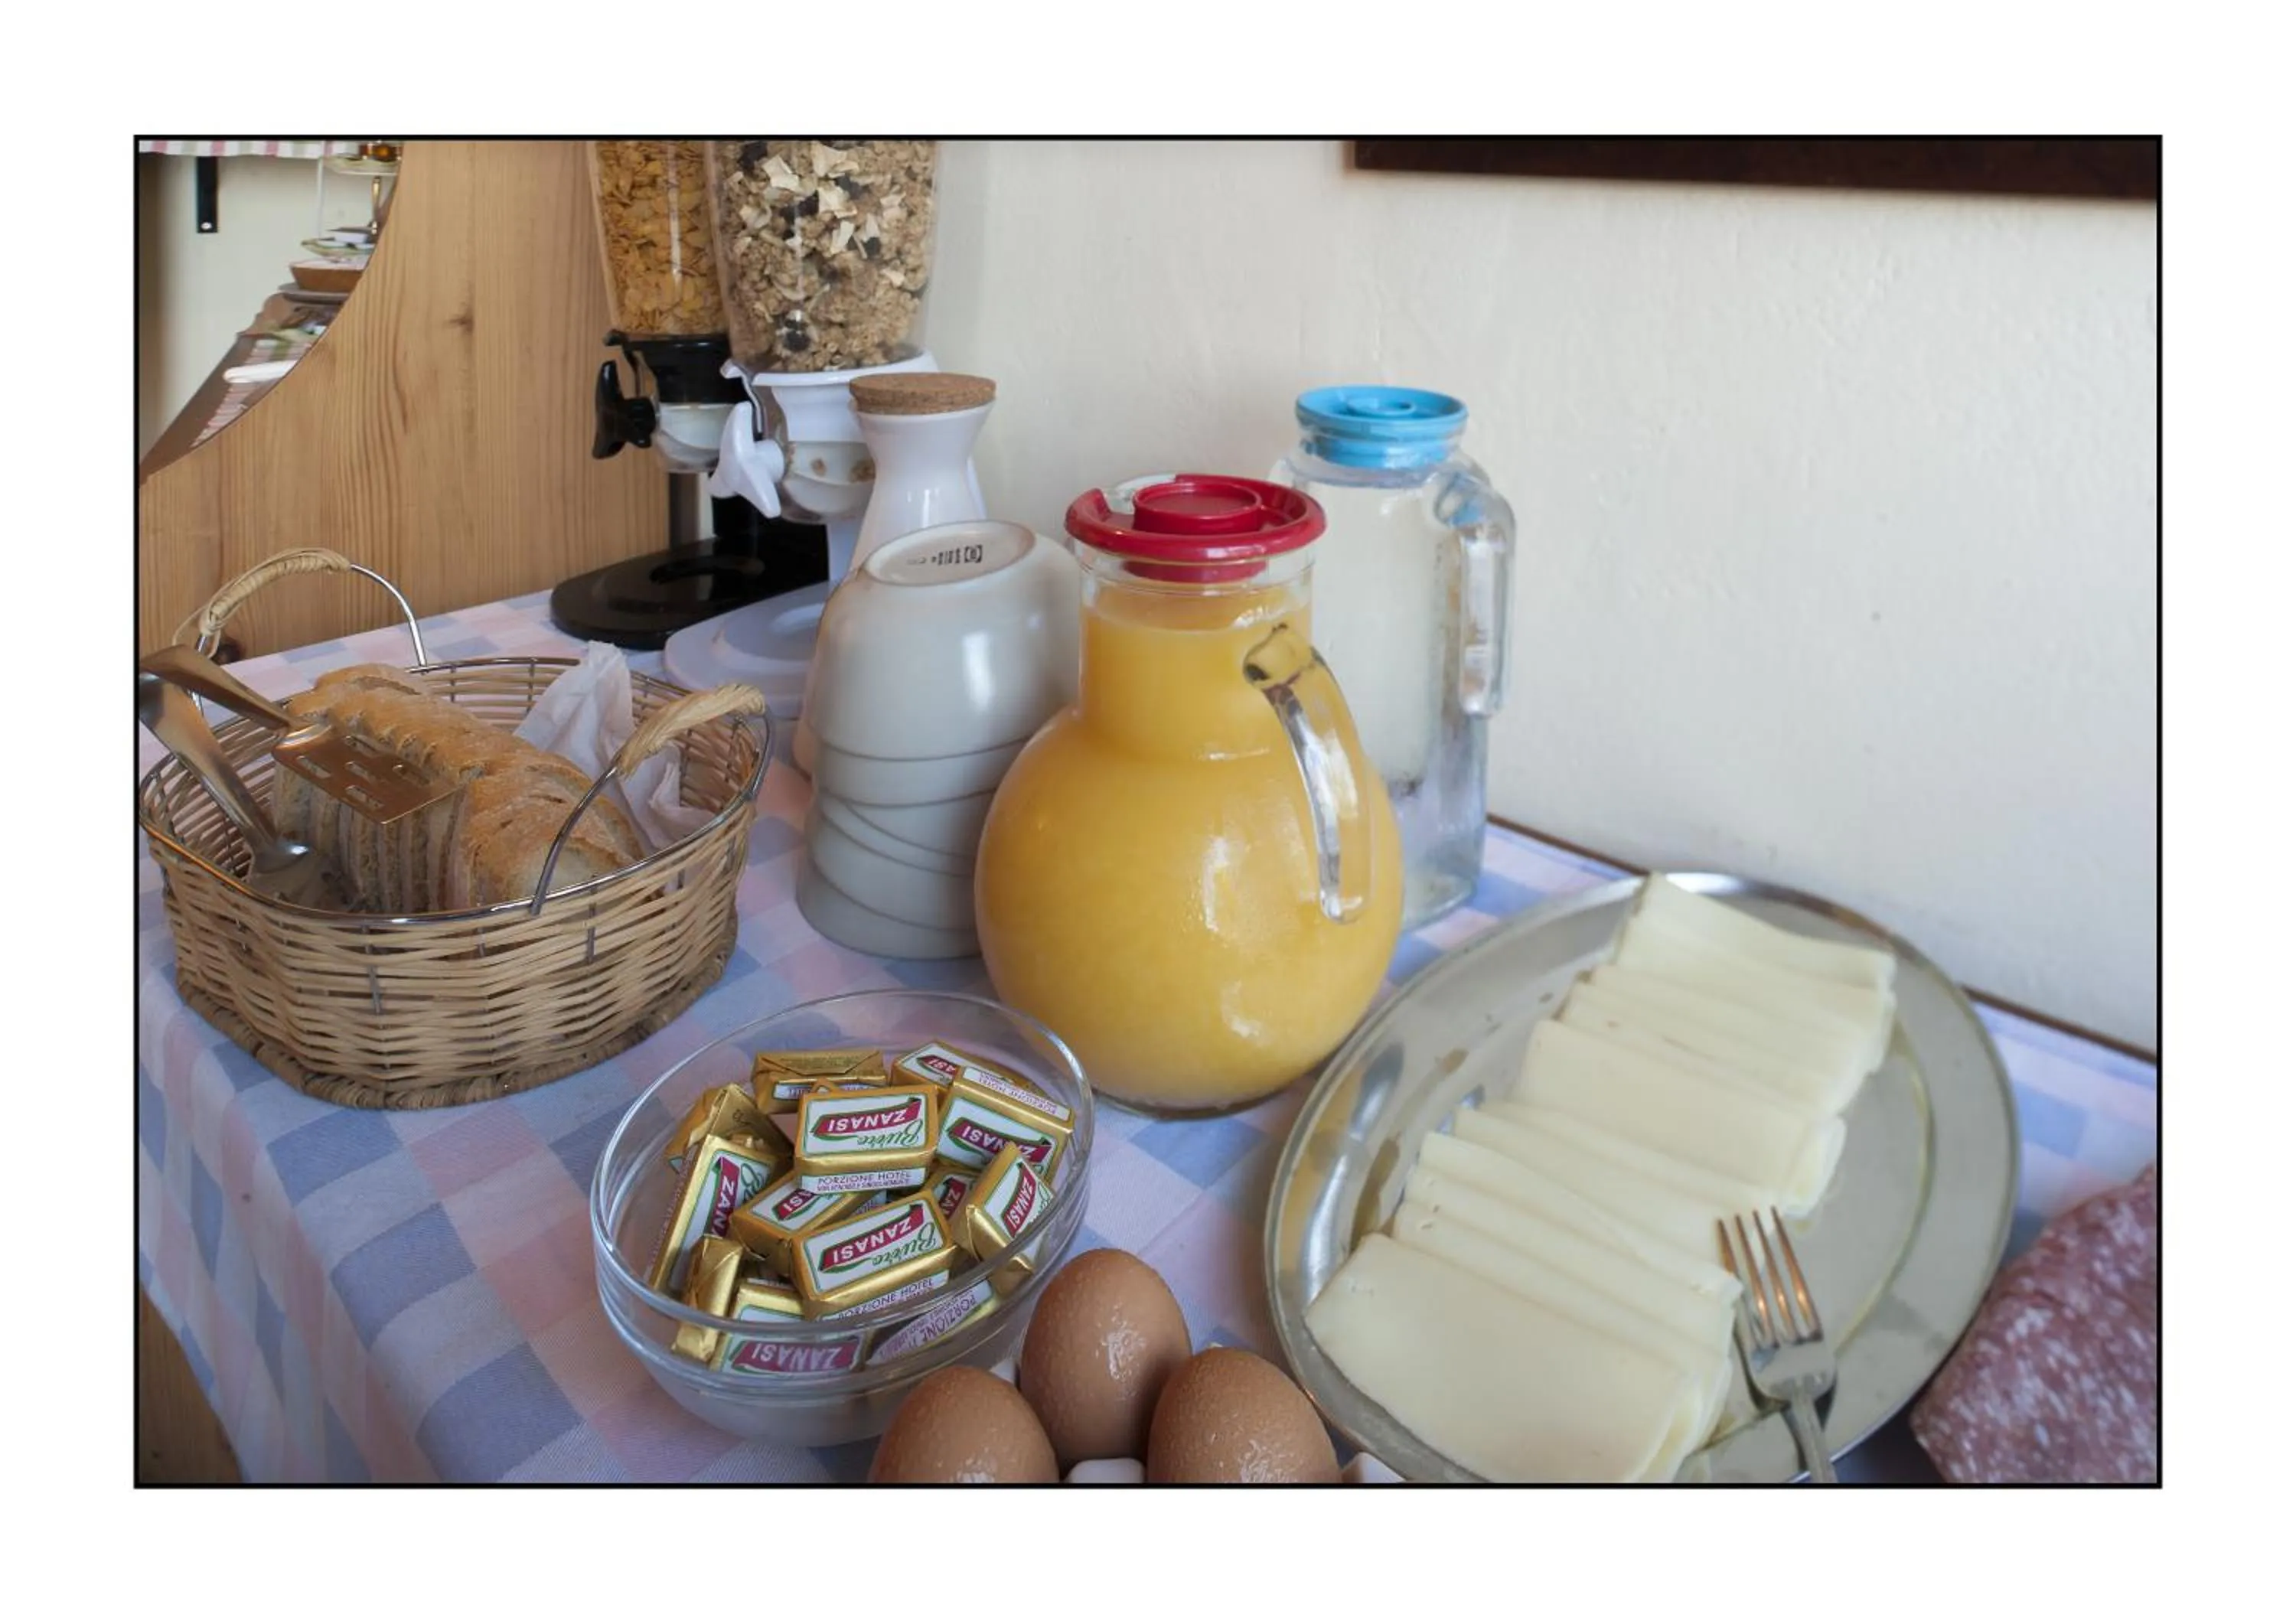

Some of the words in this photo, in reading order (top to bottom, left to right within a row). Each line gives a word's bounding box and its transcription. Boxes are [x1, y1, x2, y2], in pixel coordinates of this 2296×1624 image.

[827, 1109, 907, 1132] ZANASI
[856, 1120, 924, 1146] Burro
[961, 1125, 1036, 1158] ZNASI
[818, 1173, 874, 1184] PORZIONE
[878, 1171, 912, 1181] HOTEL
[711, 1175, 735, 1234] ZAN
[1007, 1176, 1033, 1229] ZANASI
[833, 1217, 912, 1263] ZANASI
[871, 1222, 937, 1267] Burro
[900, 1277, 934, 1297] HOTEL
[751, 1342, 843, 1371] ZANASI
